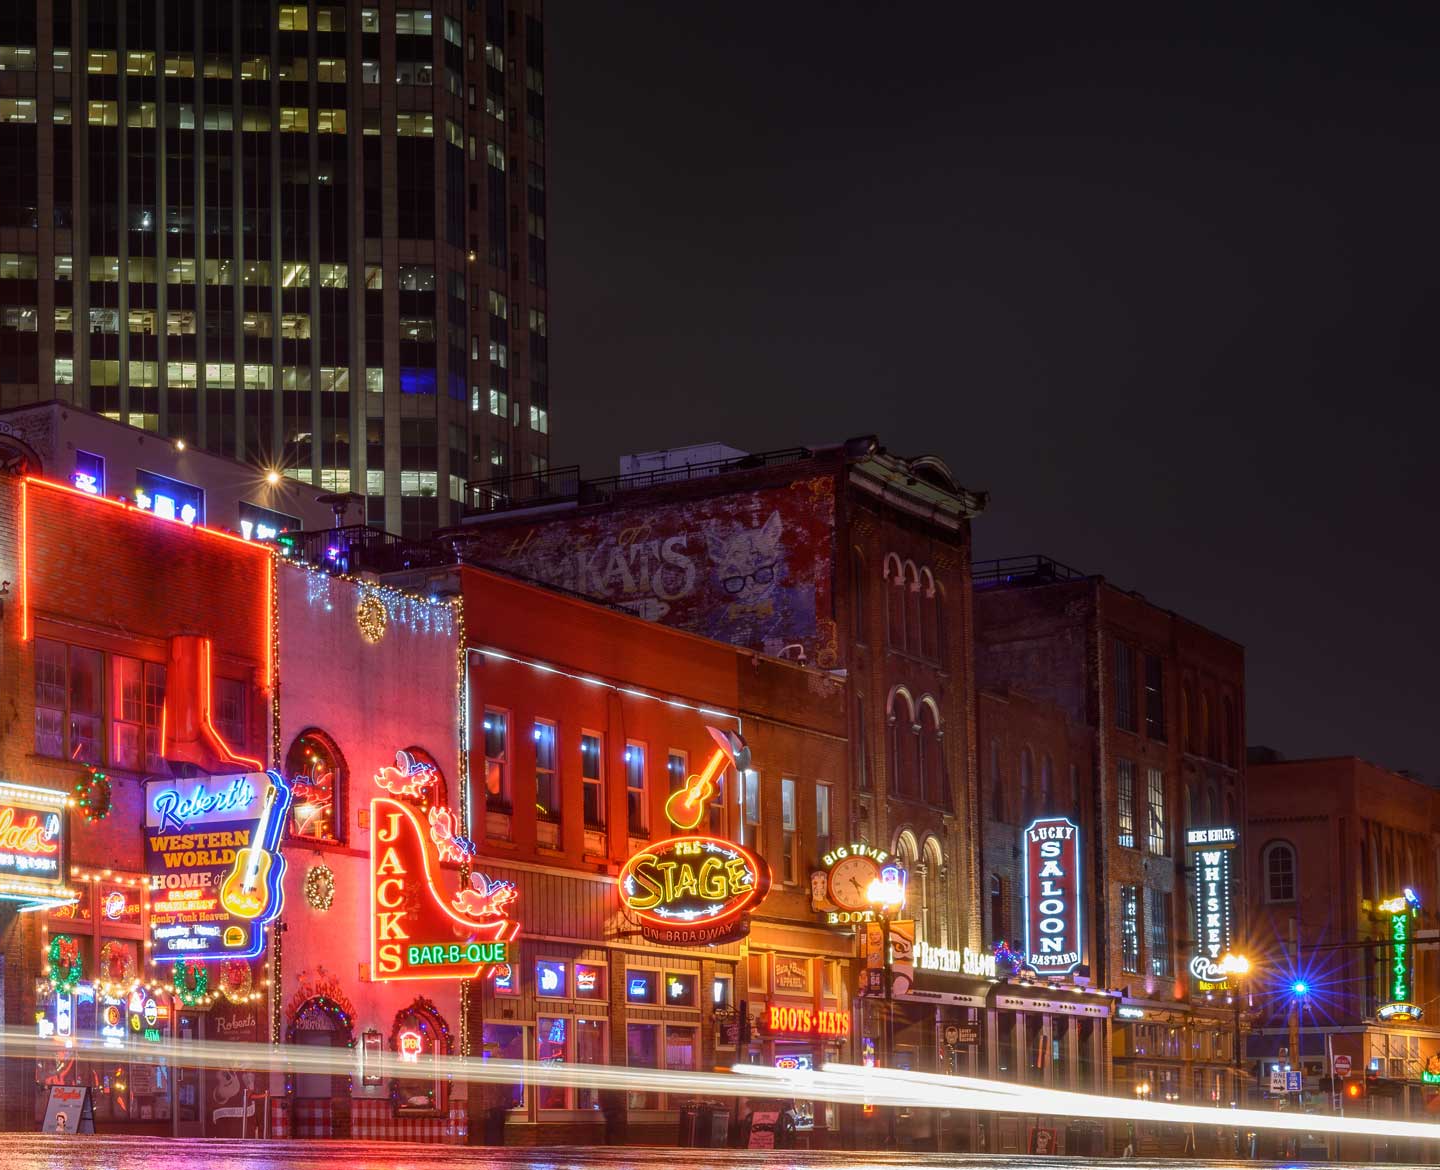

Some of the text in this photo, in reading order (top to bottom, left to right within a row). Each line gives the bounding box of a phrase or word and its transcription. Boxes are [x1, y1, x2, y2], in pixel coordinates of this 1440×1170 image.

[153, 775, 256, 834] Robert's
[149, 829, 251, 853] WESTERN
[1030, 826, 1075, 843] LUCKY
[163, 848, 236, 869] WORLD
[674, 840, 703, 855] THE
[824, 844, 888, 866] BIG TIME
[151, 869, 227, 891] HOME of
[627, 853, 753, 910] STAGE
[376, 813, 410, 973] JACKS
[1038, 841, 1065, 953] SALOON
[1202, 852, 1221, 958] WHISKEY
[150, 911, 230, 925] Honky Tonk Heaven
[643, 923, 735, 942] ON BROADWAY
[408, 943, 506, 966] BAR-B-QUE
[1031, 951, 1079, 966] BASTARD
[770, 1006, 849, 1034] BOOTS HATS
[404, 1038, 420, 1049] OPEN
